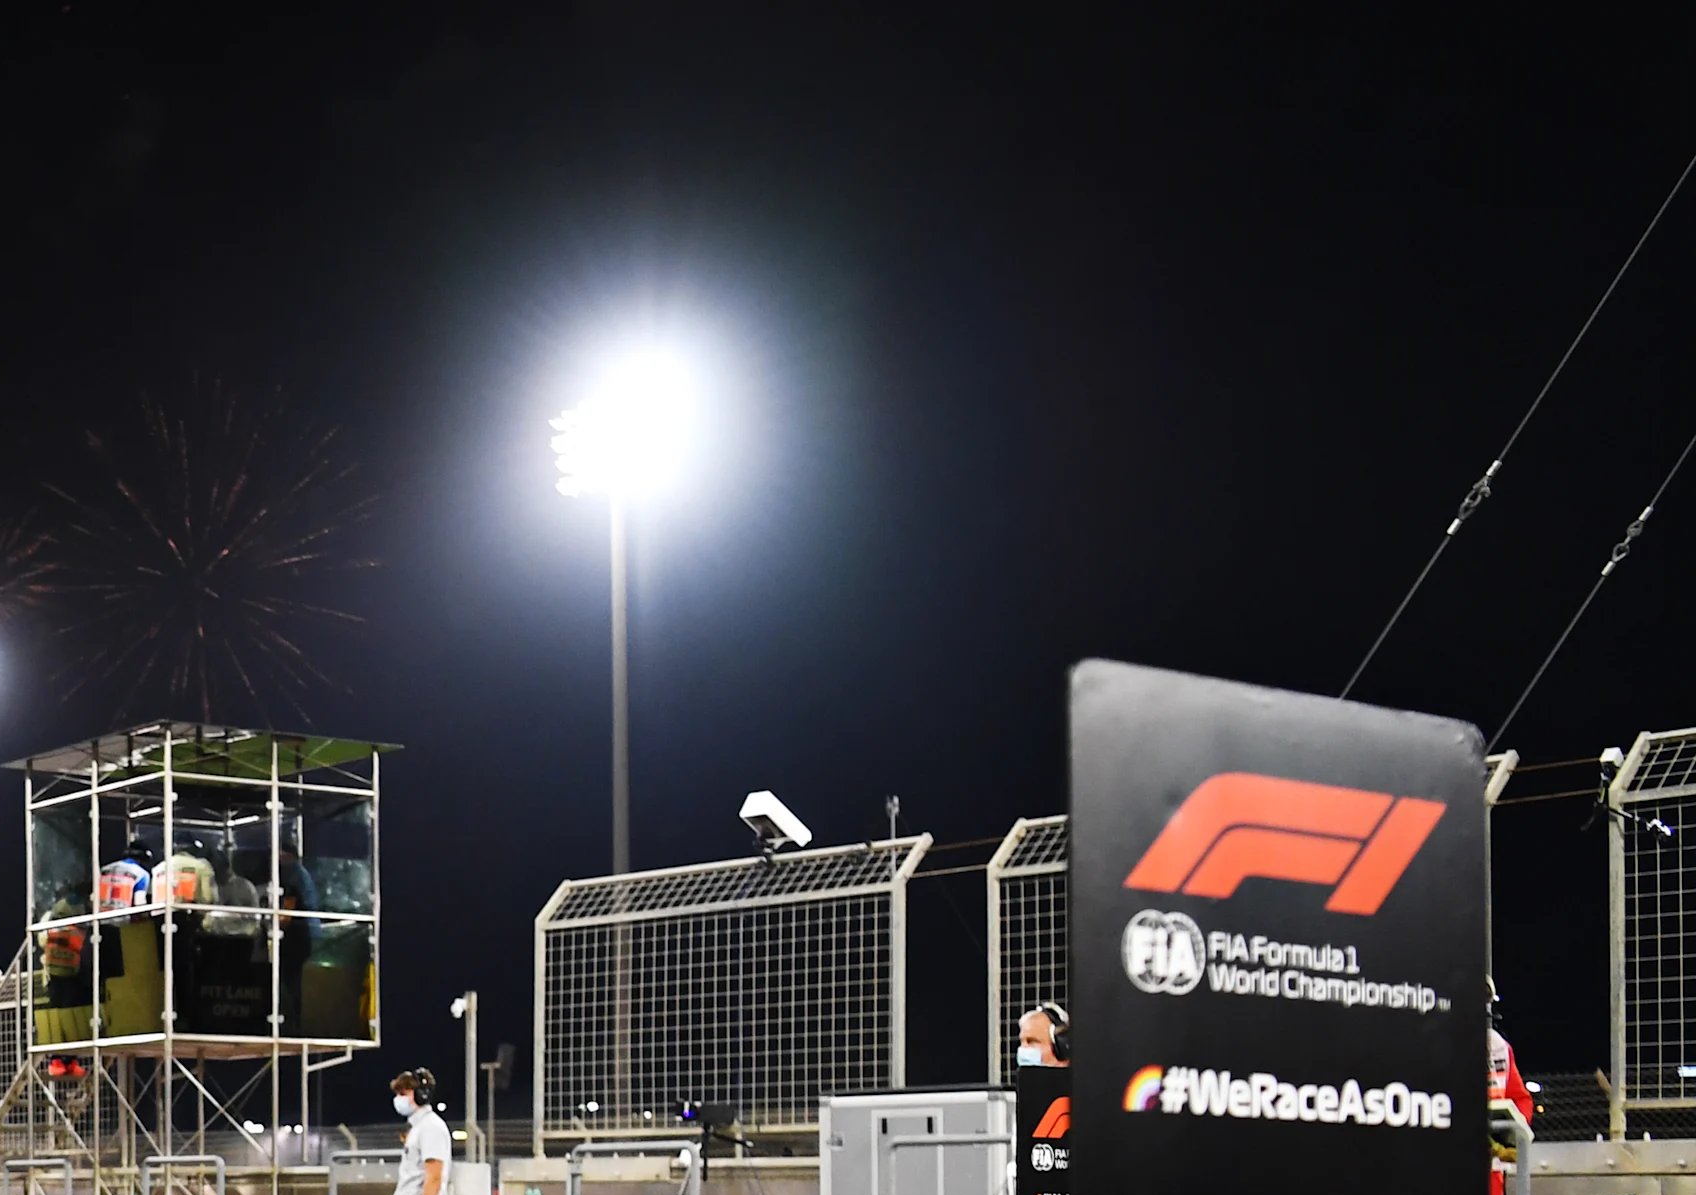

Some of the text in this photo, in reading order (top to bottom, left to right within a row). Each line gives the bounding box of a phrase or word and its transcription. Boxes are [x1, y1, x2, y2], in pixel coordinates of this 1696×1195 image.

[1125, 919, 1200, 986] FIA
[1208, 931, 1360, 975] FIA Formula 1
[1208, 963, 1280, 997] World
[1281, 969, 1435, 1016] Championship
[1159, 1066, 1452, 1129] #WeRaceAsOne
